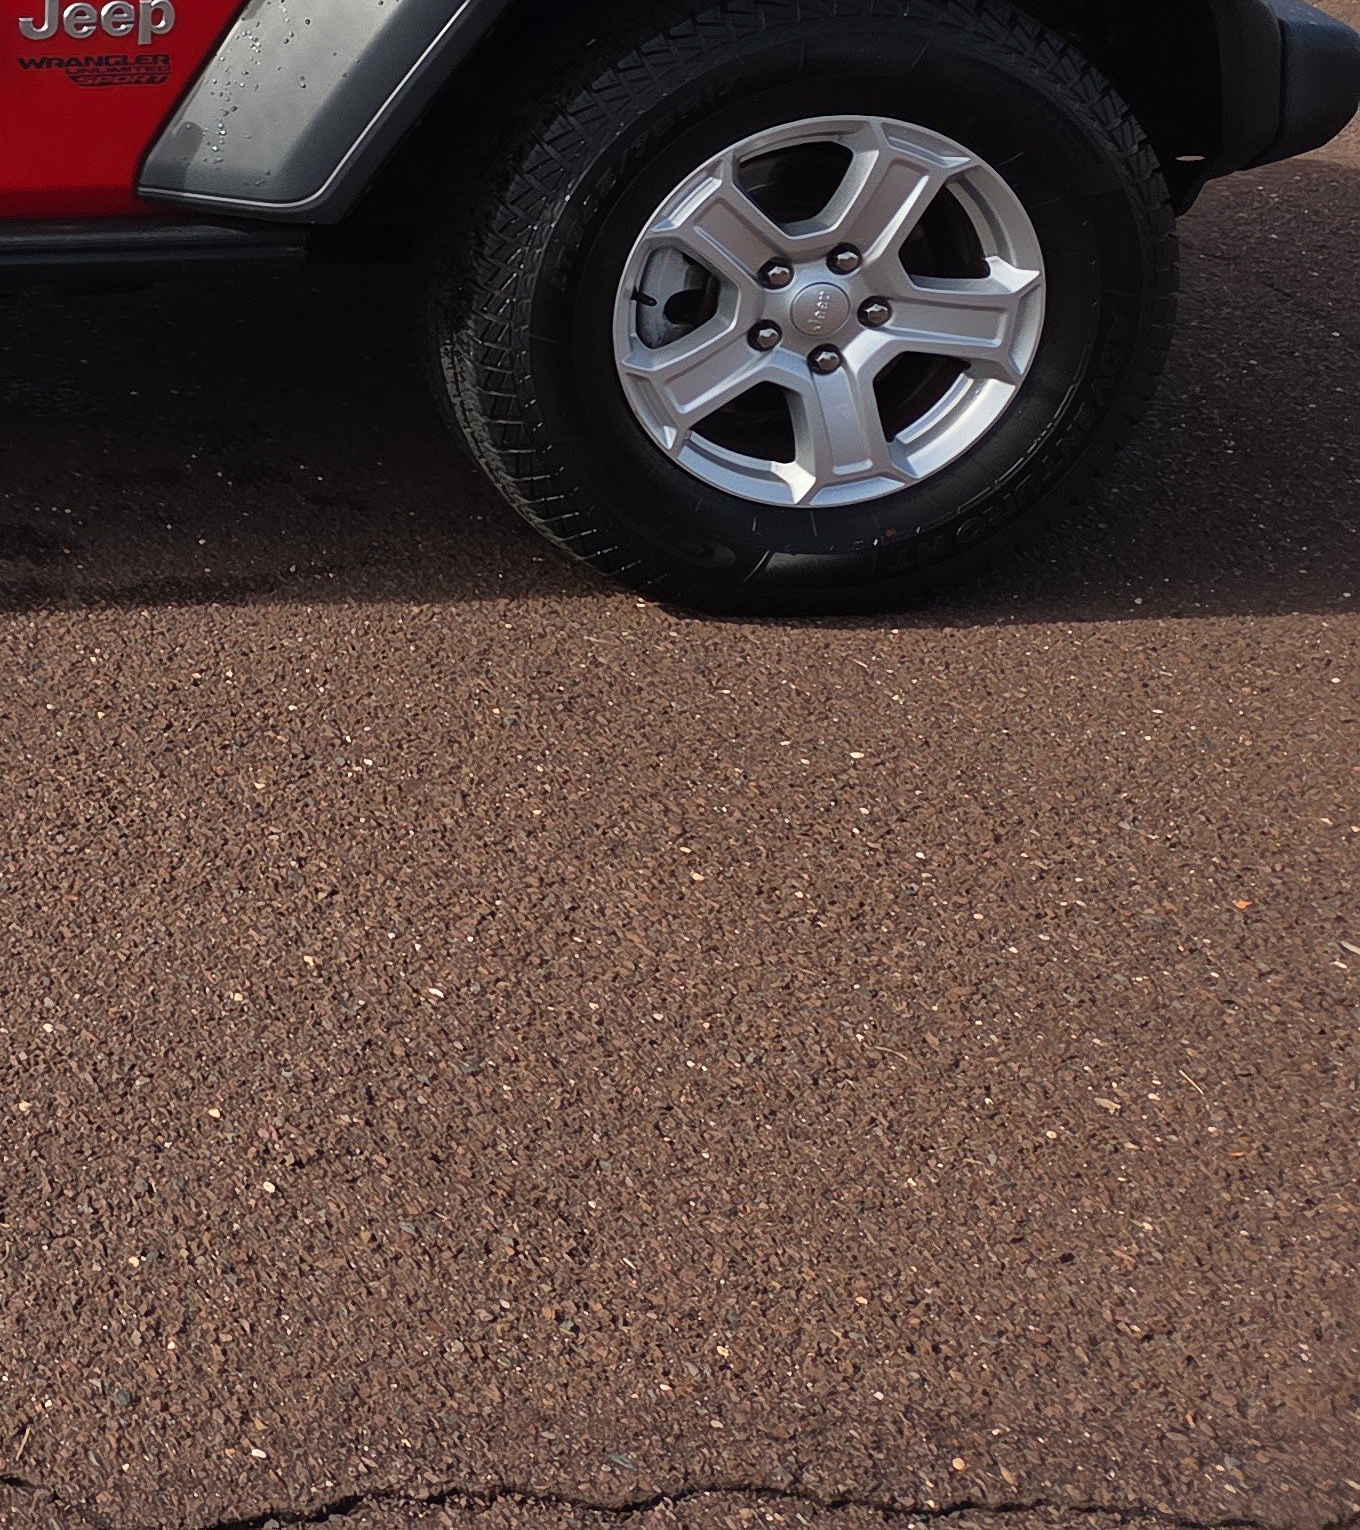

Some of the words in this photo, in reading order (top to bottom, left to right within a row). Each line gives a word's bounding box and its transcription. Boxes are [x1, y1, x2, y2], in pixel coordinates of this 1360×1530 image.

[17, 53, 171, 70] WRANGLER
[65, 66, 171, 75] UNLIMITED
[76, 74, 166, 85] SPORT
